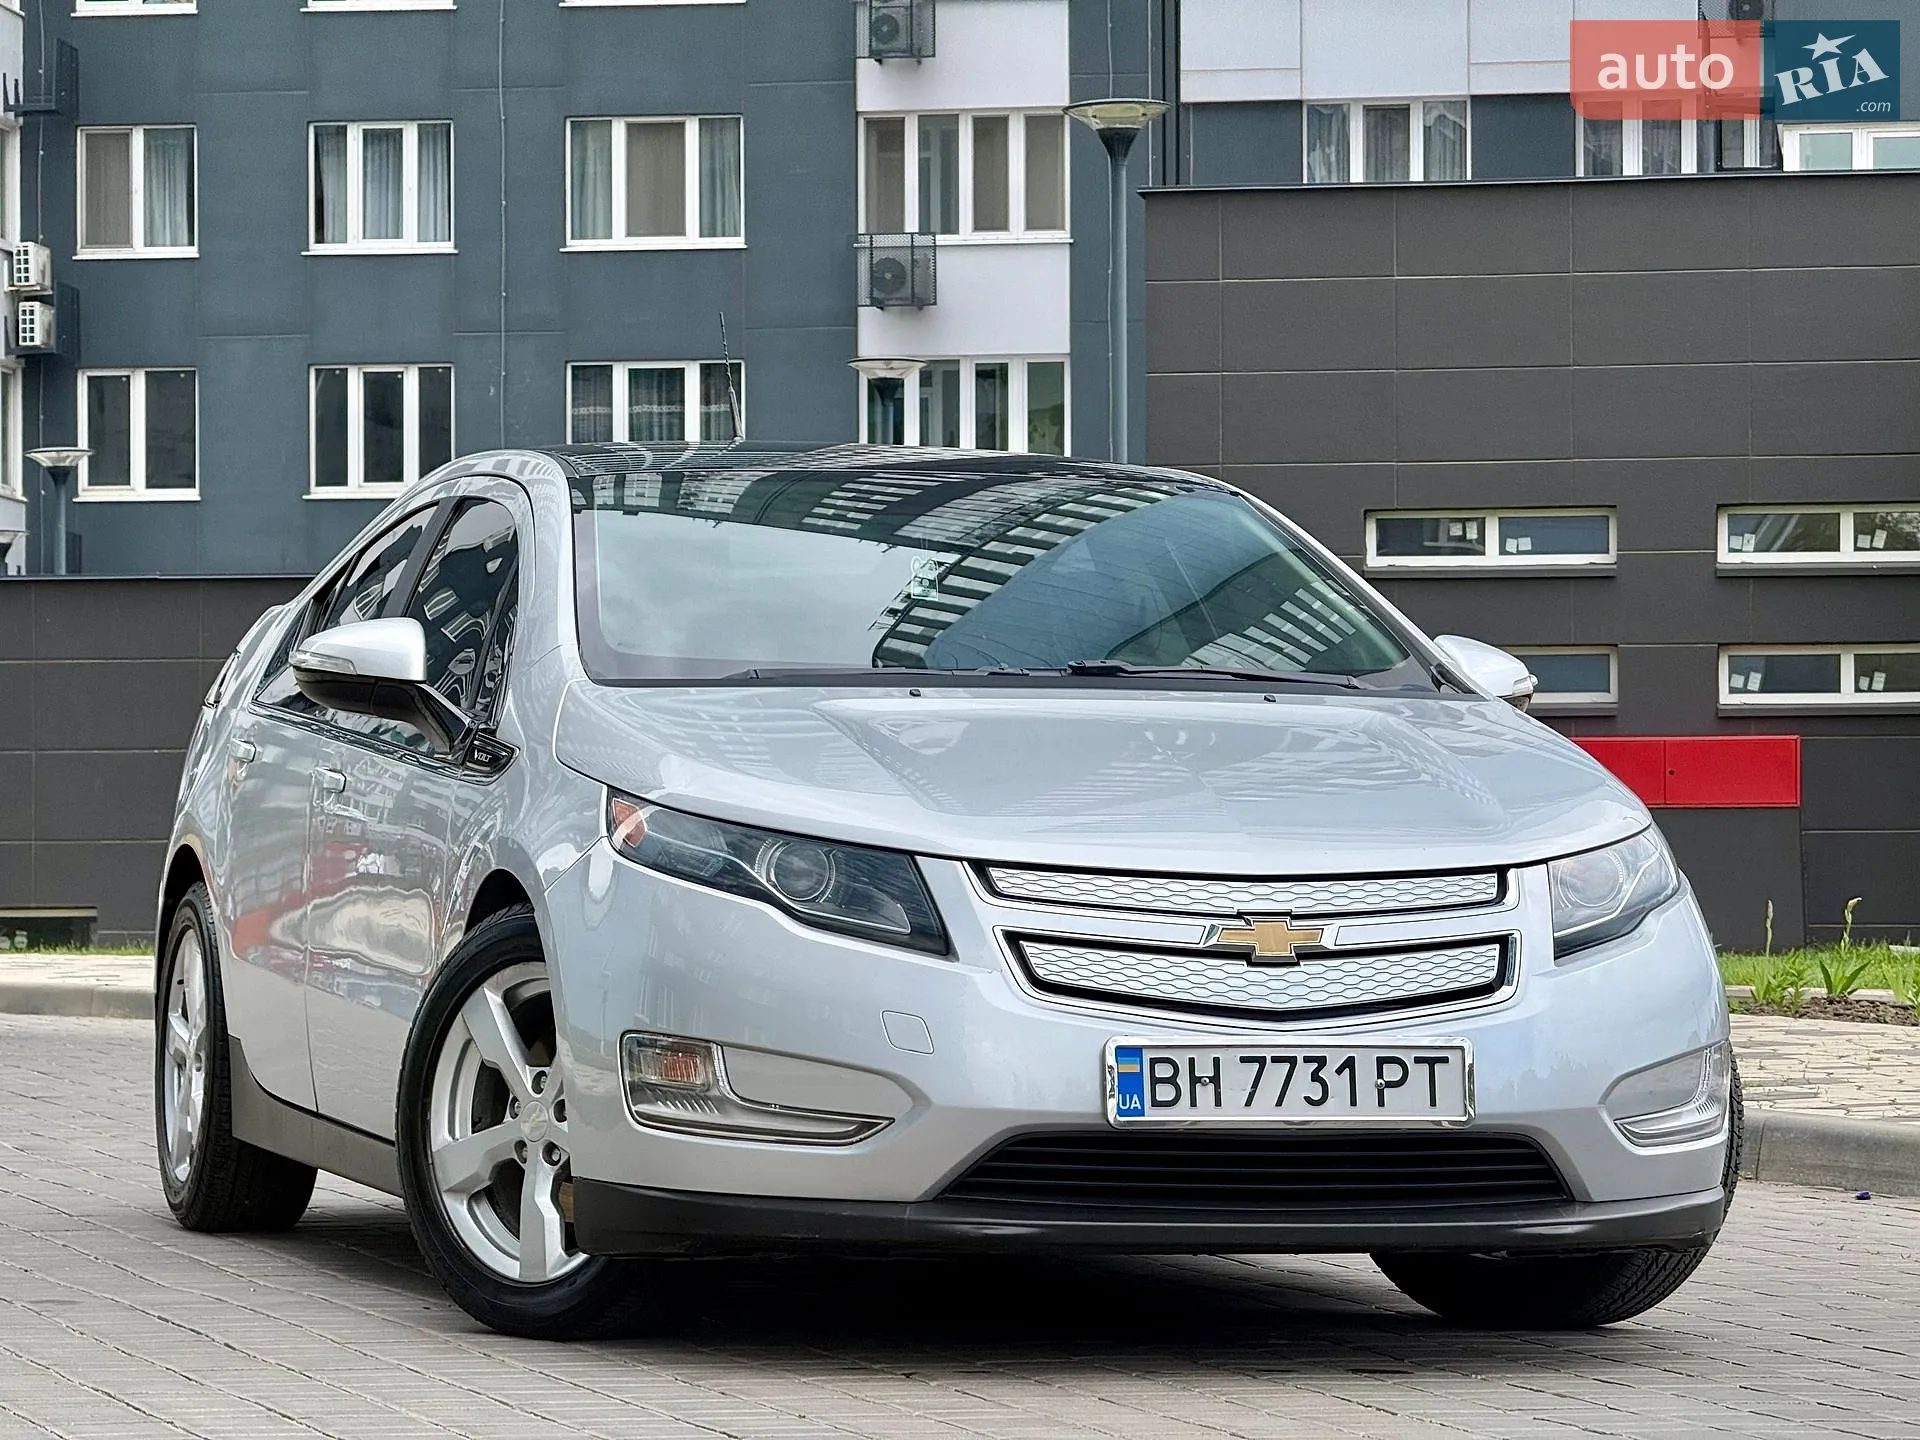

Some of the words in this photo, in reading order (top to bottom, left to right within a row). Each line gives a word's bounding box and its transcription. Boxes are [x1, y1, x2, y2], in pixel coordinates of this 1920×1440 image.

[474, 748, 492, 762] VOLT
[1148, 1056, 1221, 1109] BH
[1239, 1055, 1358, 1108] 7731
[1375, 1055, 1450, 1108] PT
[1118, 1093, 1142, 1110] UA
